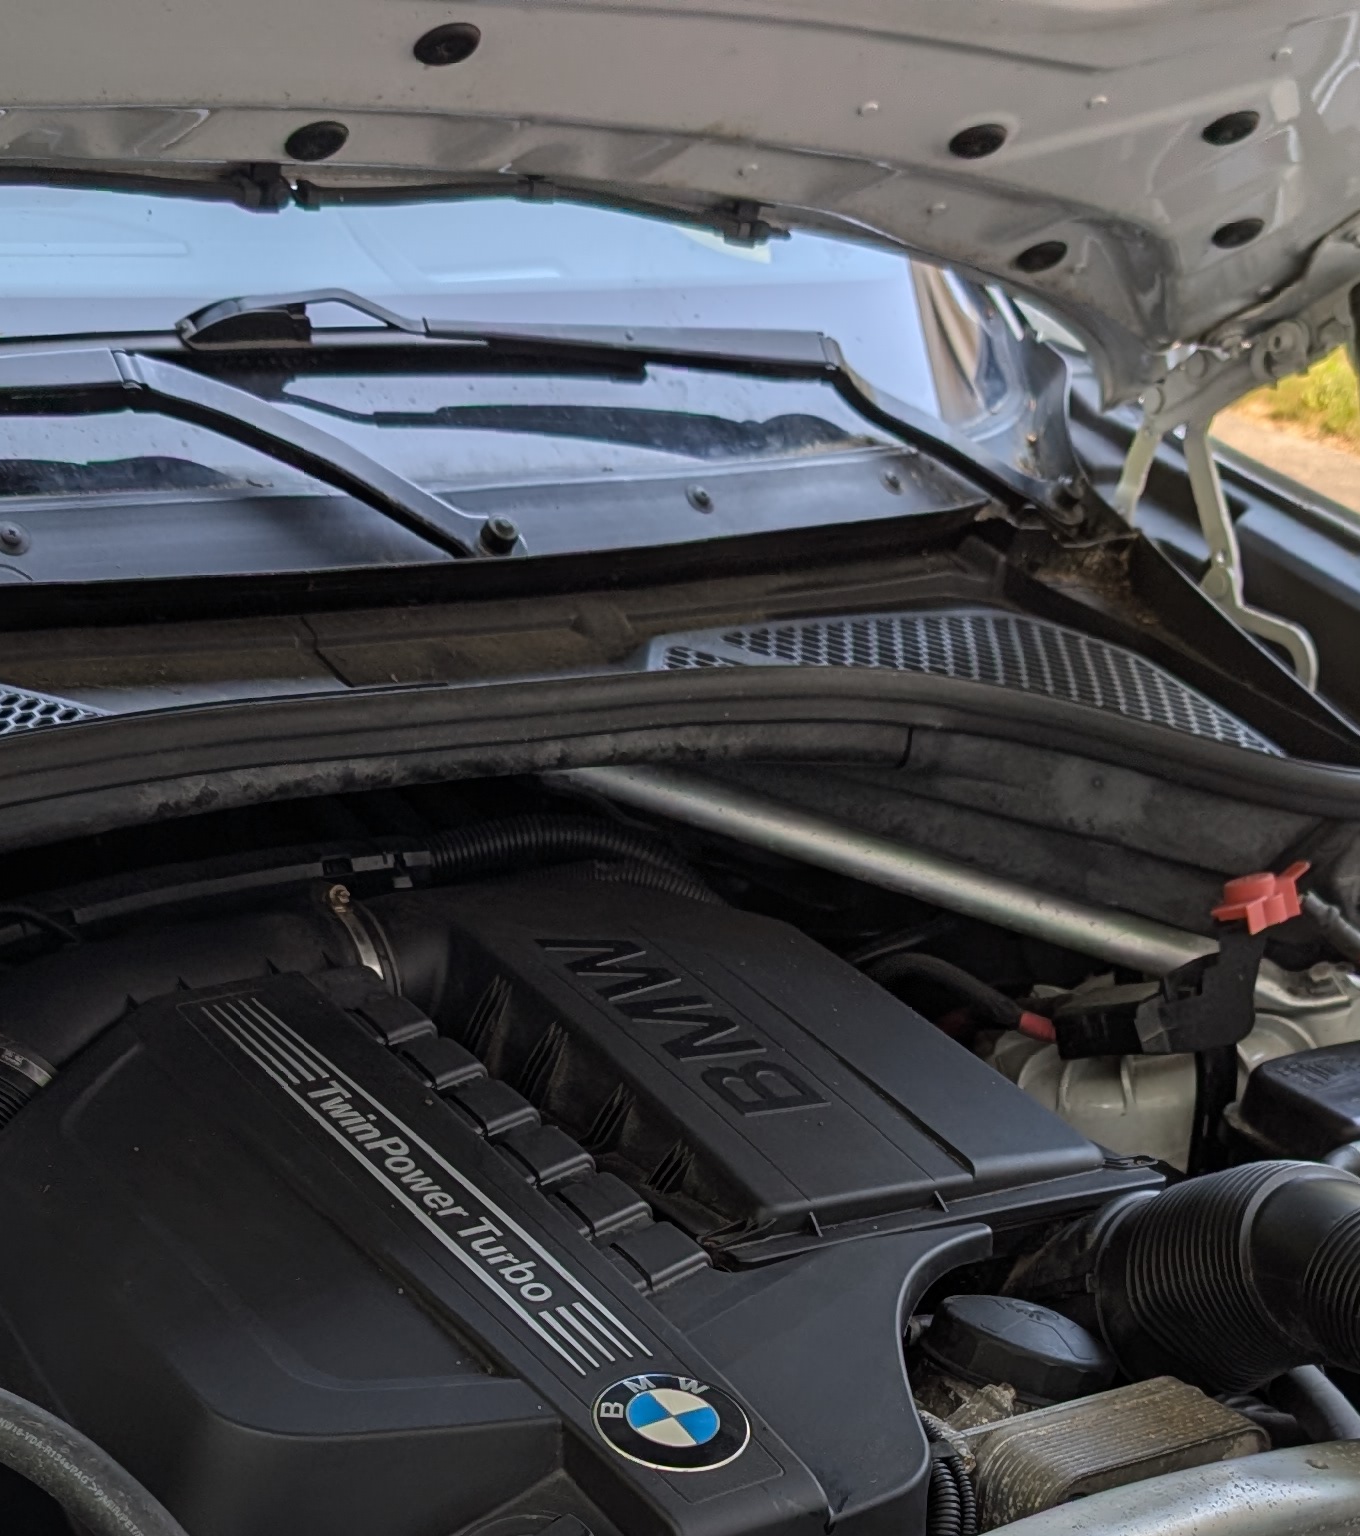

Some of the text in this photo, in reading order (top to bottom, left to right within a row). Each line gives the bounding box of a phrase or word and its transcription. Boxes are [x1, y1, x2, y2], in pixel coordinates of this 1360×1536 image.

[534, 938, 832, 1118] BMW
[306, 1079, 553, 1303] TwinPower Turbo
[599, 1375, 711, 1420] BMW
